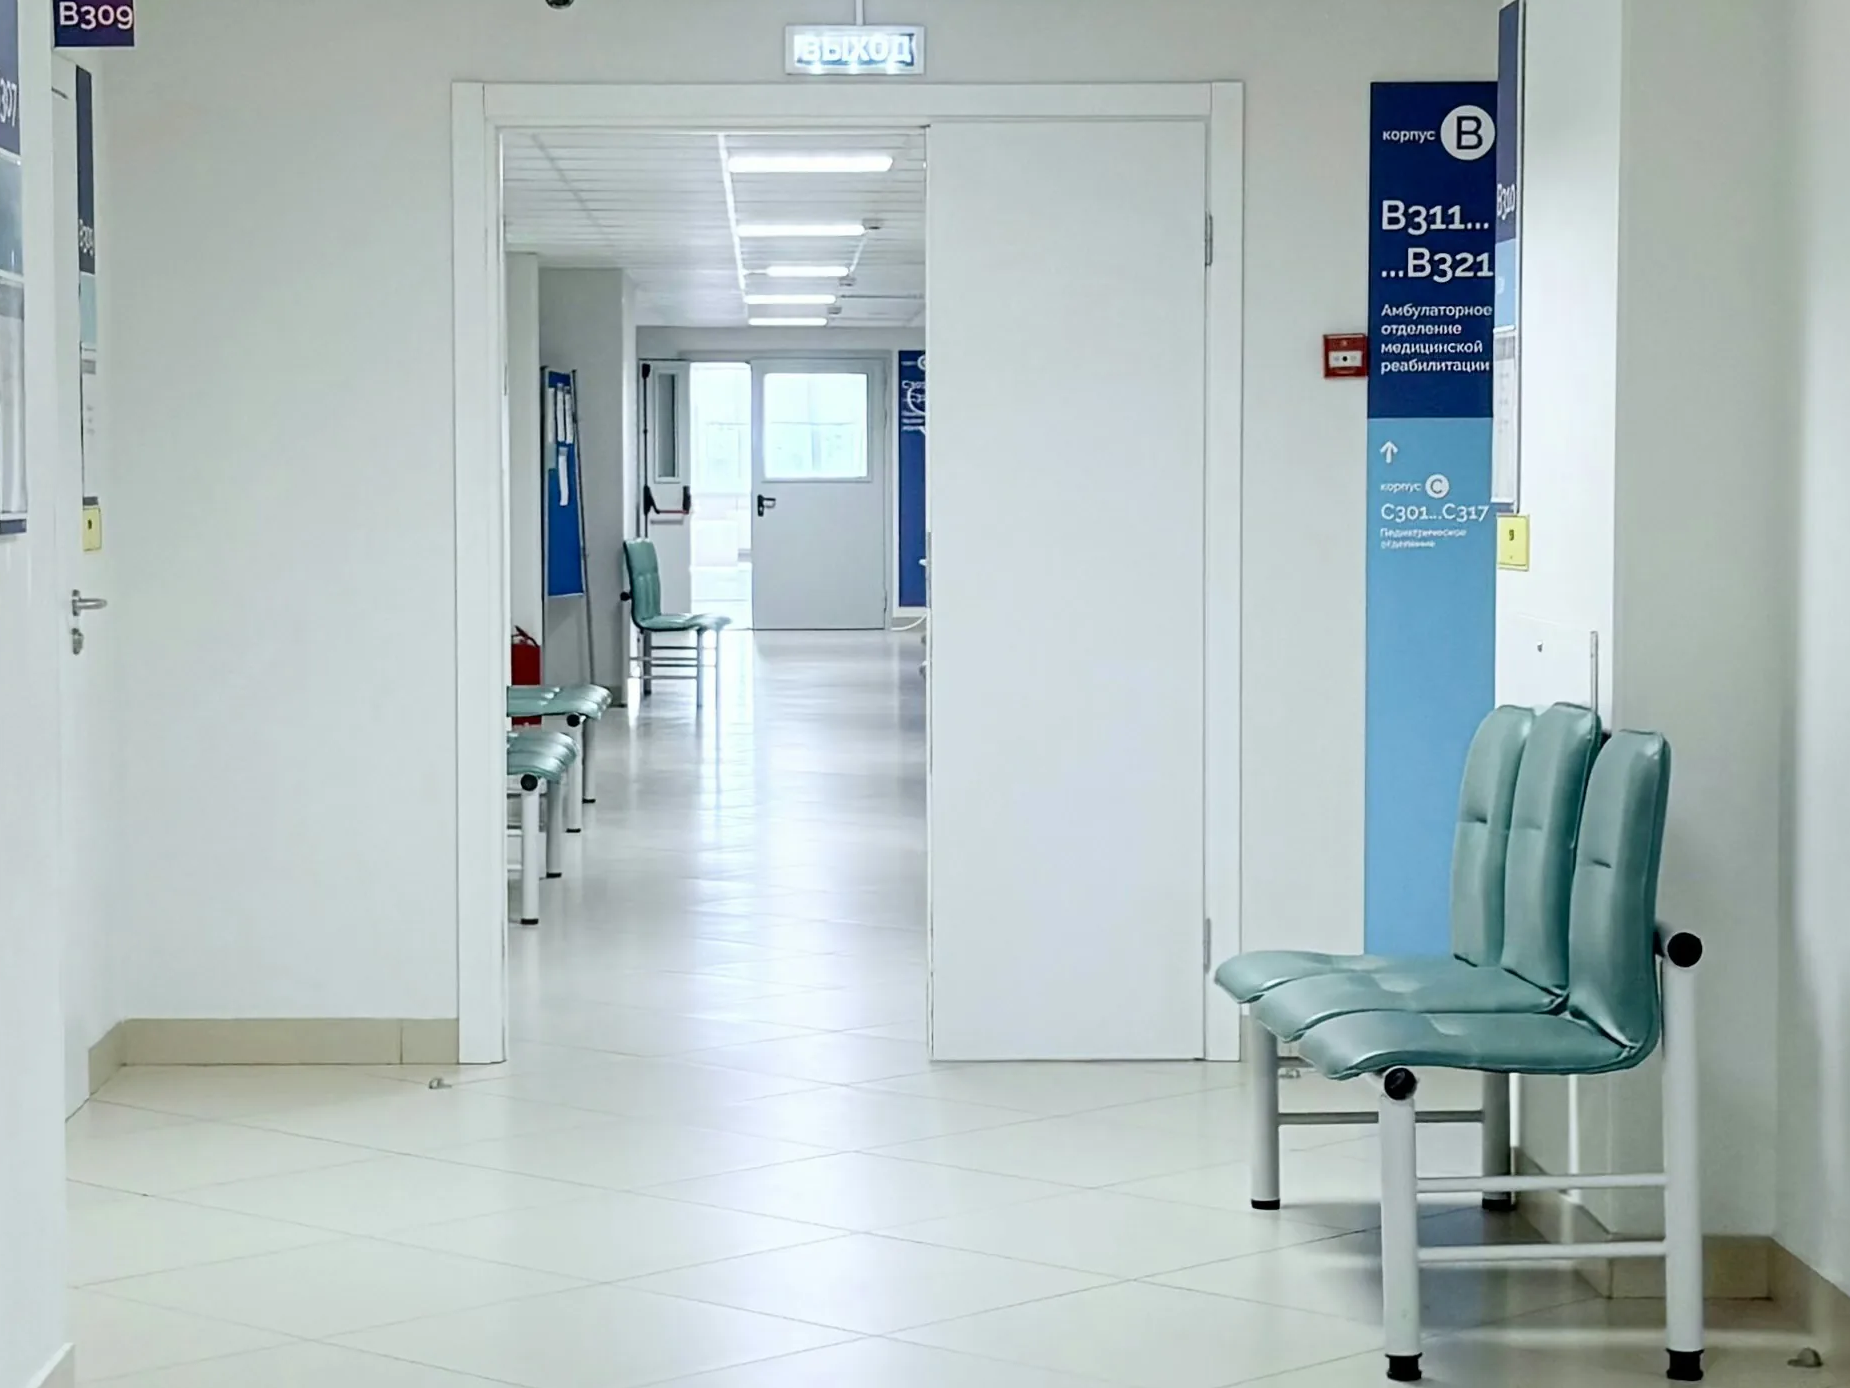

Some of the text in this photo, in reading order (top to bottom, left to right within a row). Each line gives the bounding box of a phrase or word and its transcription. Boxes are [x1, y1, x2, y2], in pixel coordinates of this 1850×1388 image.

[58, 0, 134, 30] B309
[800, 33, 914, 64] ВЫХОД
[1382, 129, 1436, 144] корпус
[1456, 115, 1483, 150] B
[1381, 199, 1490, 236] B311...
[1381, 247, 1495, 283] ...B321
[1381, 303, 1493, 320] Амбулаторное
[1381, 324, 1462, 337] отделение
[1381, 340, 1483, 355] медицинской
[1381, 359, 1490, 375] реабилитации
[1380, 481, 1422, 494] корпус
